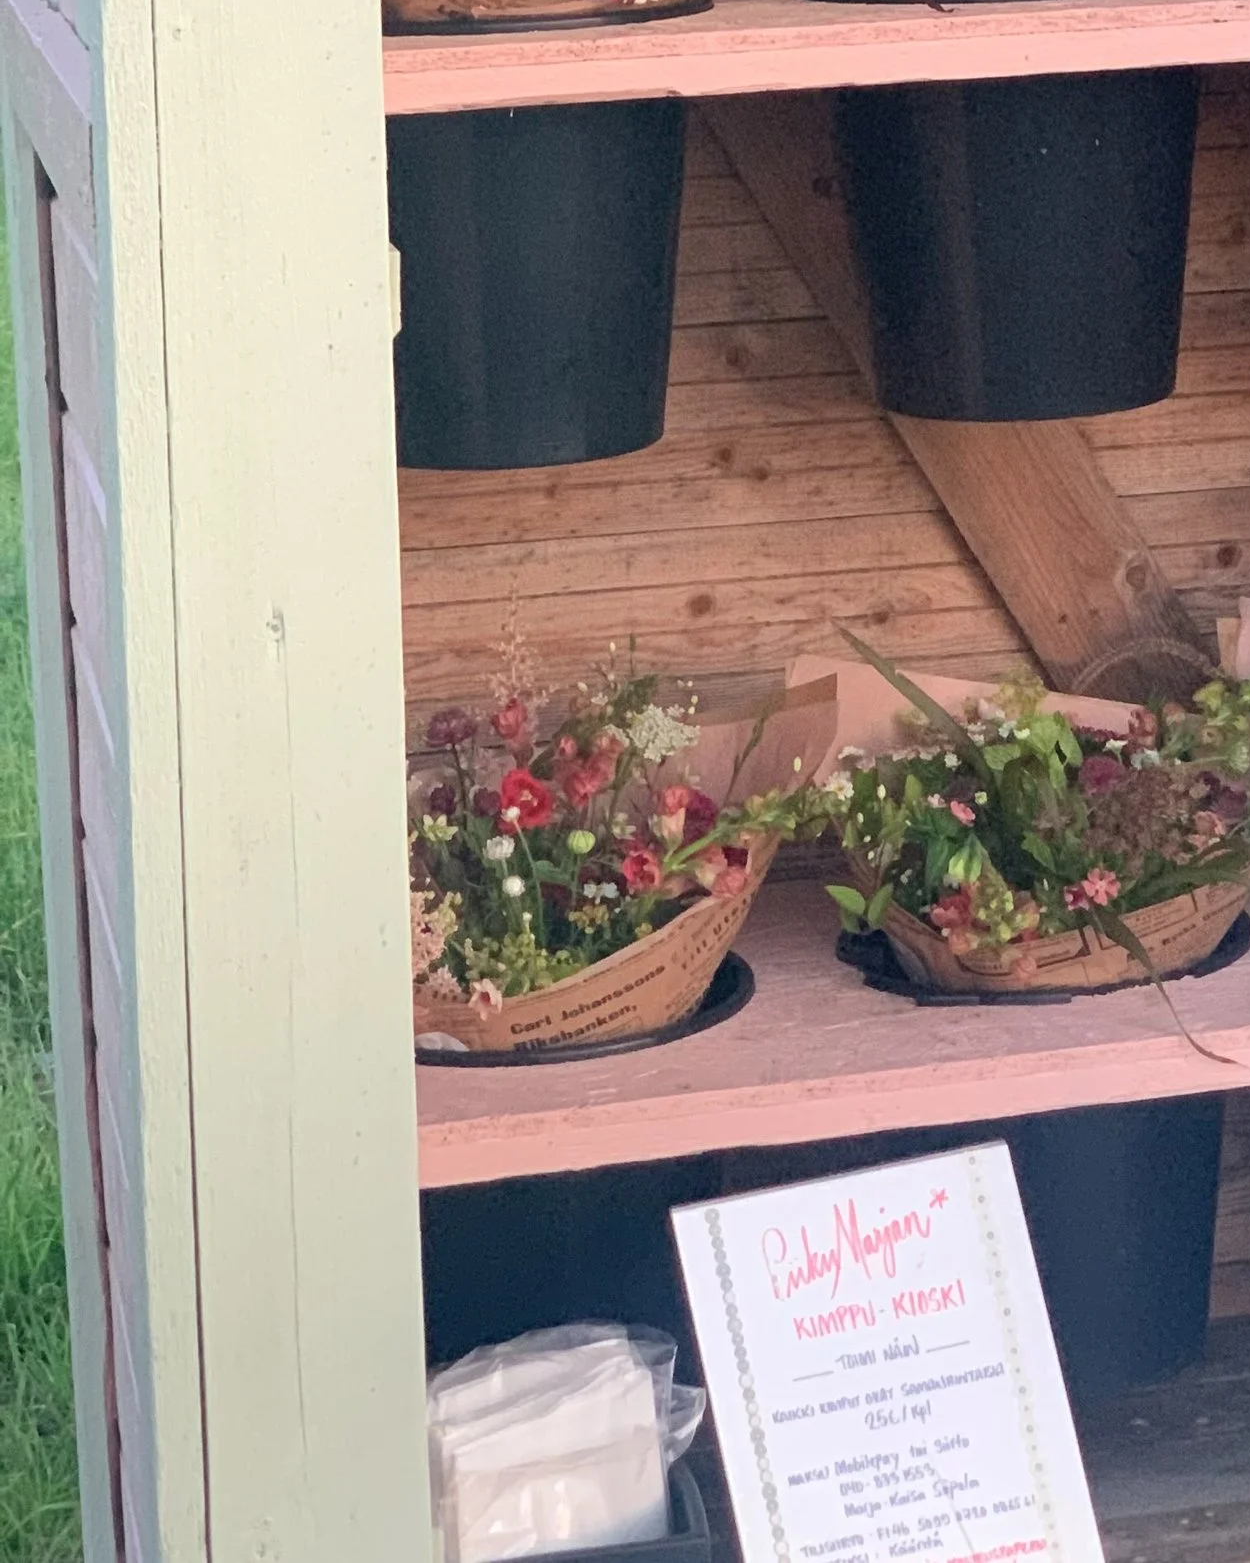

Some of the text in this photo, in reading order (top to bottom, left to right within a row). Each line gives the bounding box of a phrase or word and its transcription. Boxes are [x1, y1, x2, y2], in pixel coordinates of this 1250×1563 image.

[509, 1014, 553, 1036] Carl
[835, 1335, 920, 1370] TOIMI NÄIN
